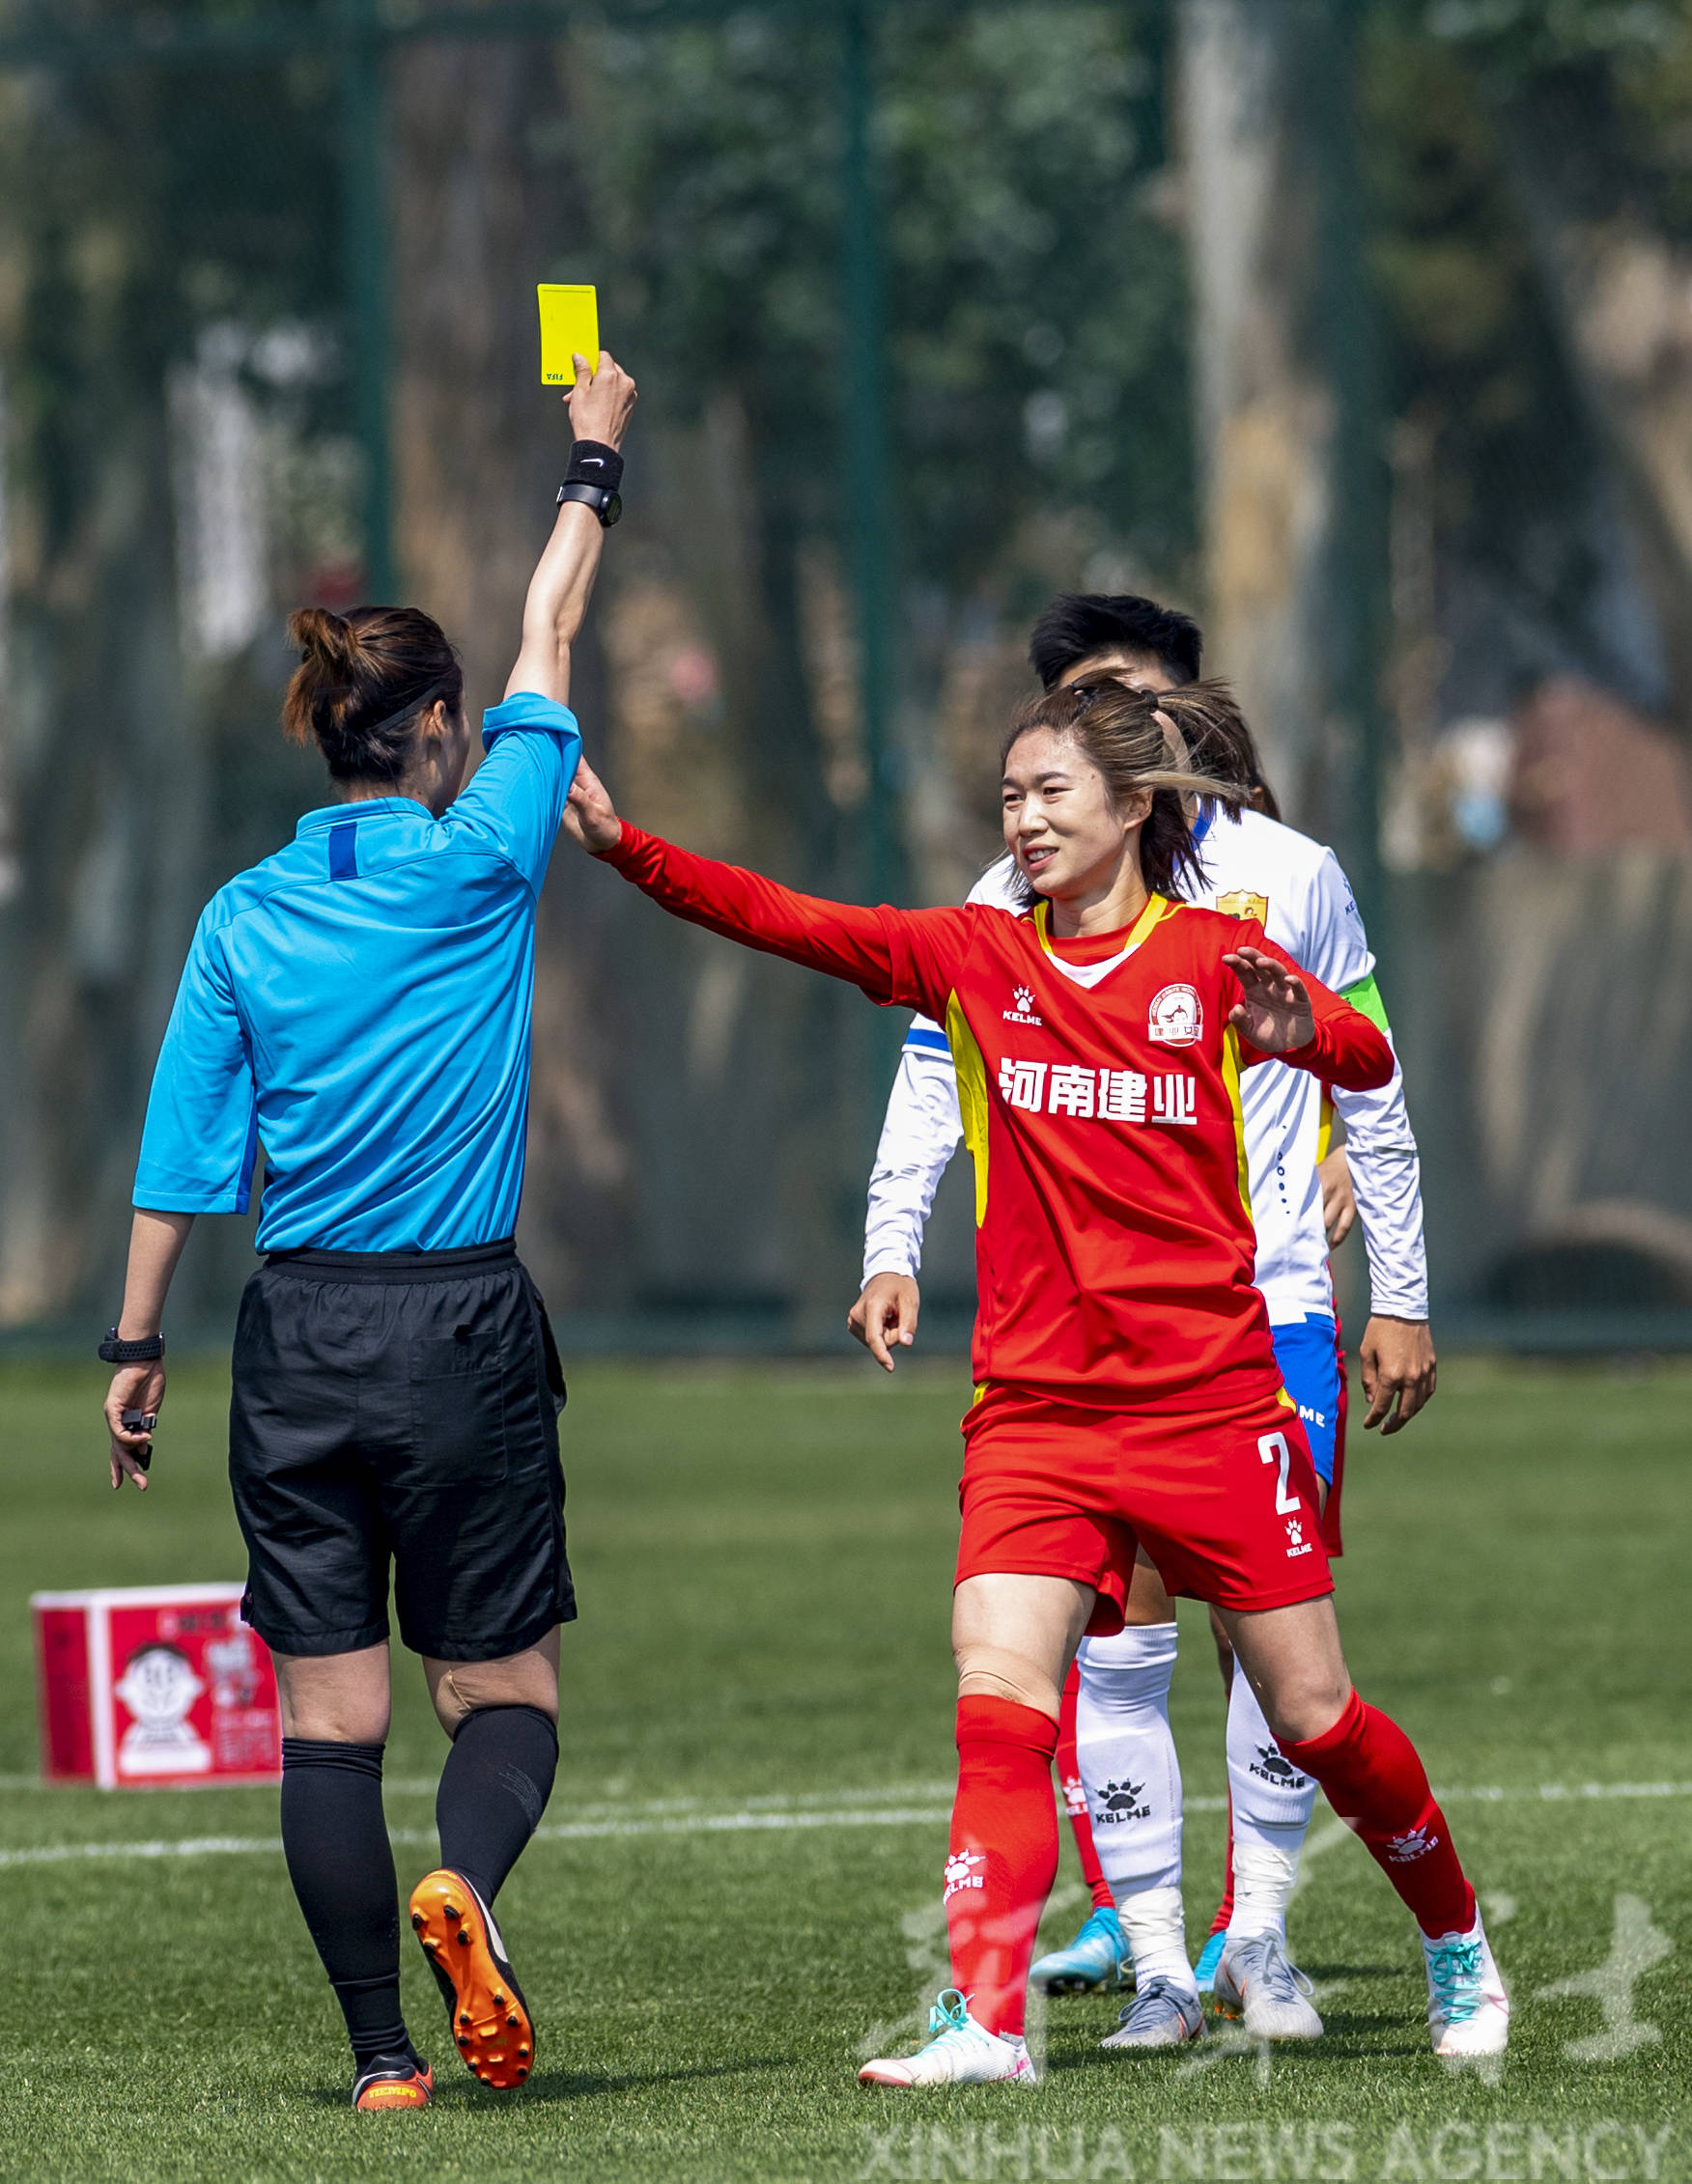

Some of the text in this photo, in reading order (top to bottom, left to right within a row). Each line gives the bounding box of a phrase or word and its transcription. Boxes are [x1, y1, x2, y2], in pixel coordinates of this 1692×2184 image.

[1002, 1010, 1043, 1026] KELME
[998, 1056, 1198, 1126] 河南建业
[1257, 1431, 1302, 1516] 2
[1285, 1542, 1313, 1558] KELME
[1249, 1762, 1306, 1789] KELME
[1095, 1804, 1151, 1824] KELME
